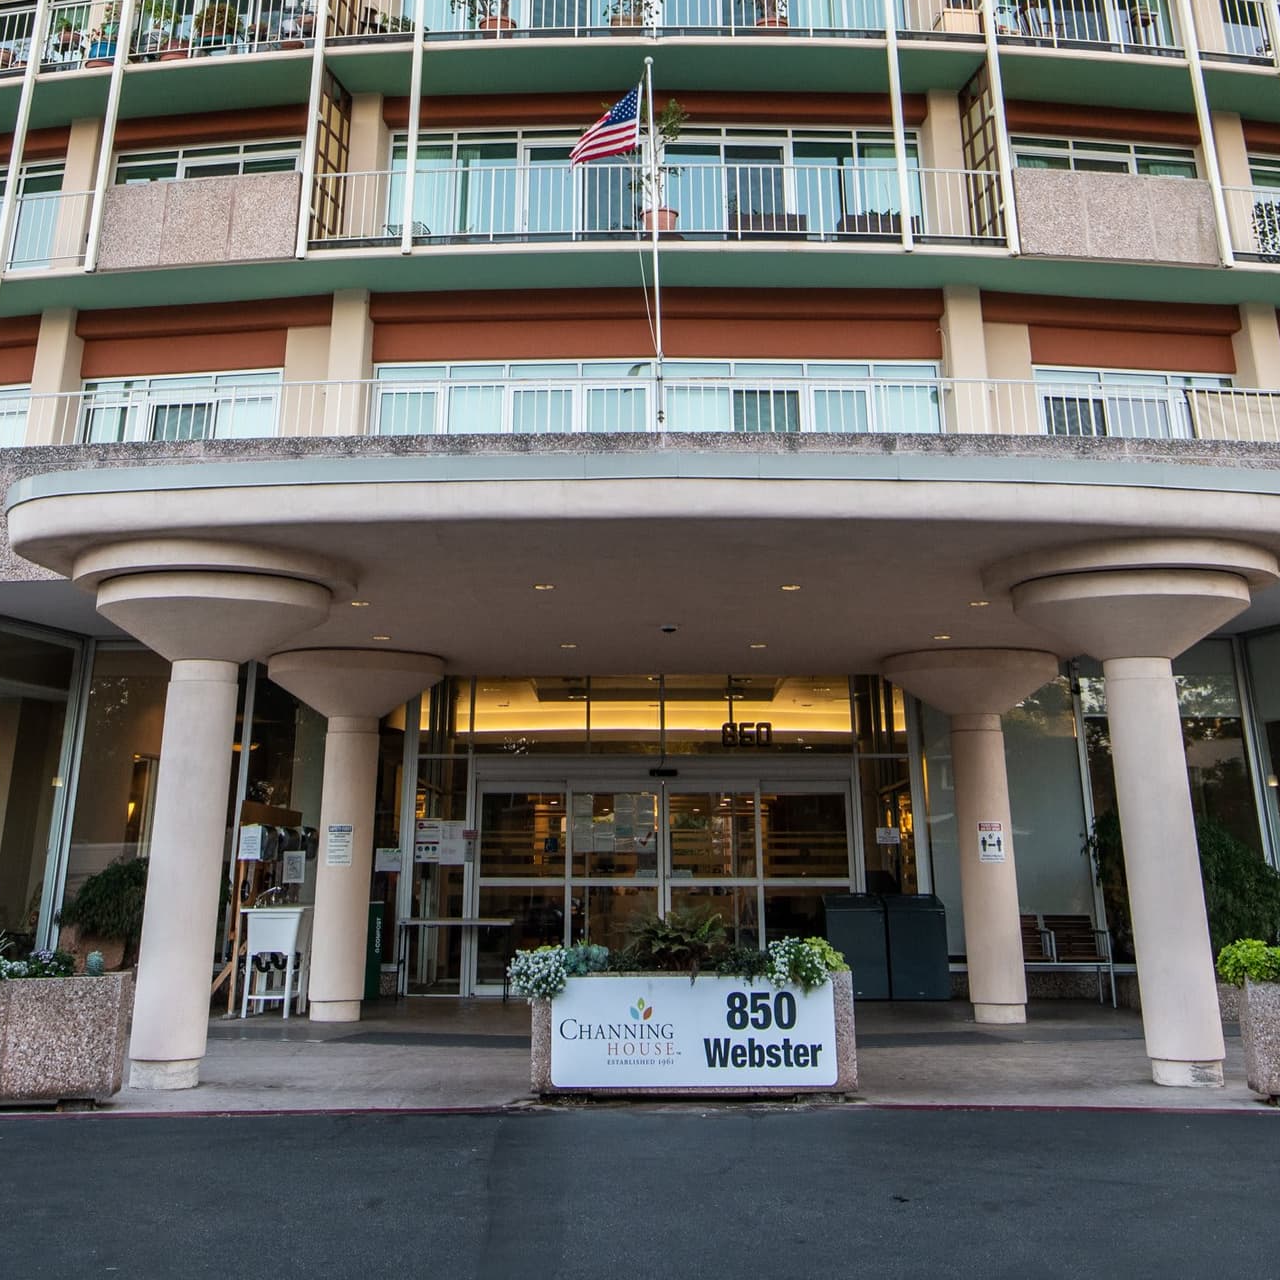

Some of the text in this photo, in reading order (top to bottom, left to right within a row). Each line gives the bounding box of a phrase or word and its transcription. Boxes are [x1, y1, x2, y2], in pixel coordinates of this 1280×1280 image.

[722, 722, 772, 746] 850
[726, 991, 797, 1031] 850
[560, 1019, 674, 1041] CHANNING
[607, 1042, 675, 1056] HOUSE
[704, 1038, 823, 1068] Webster
